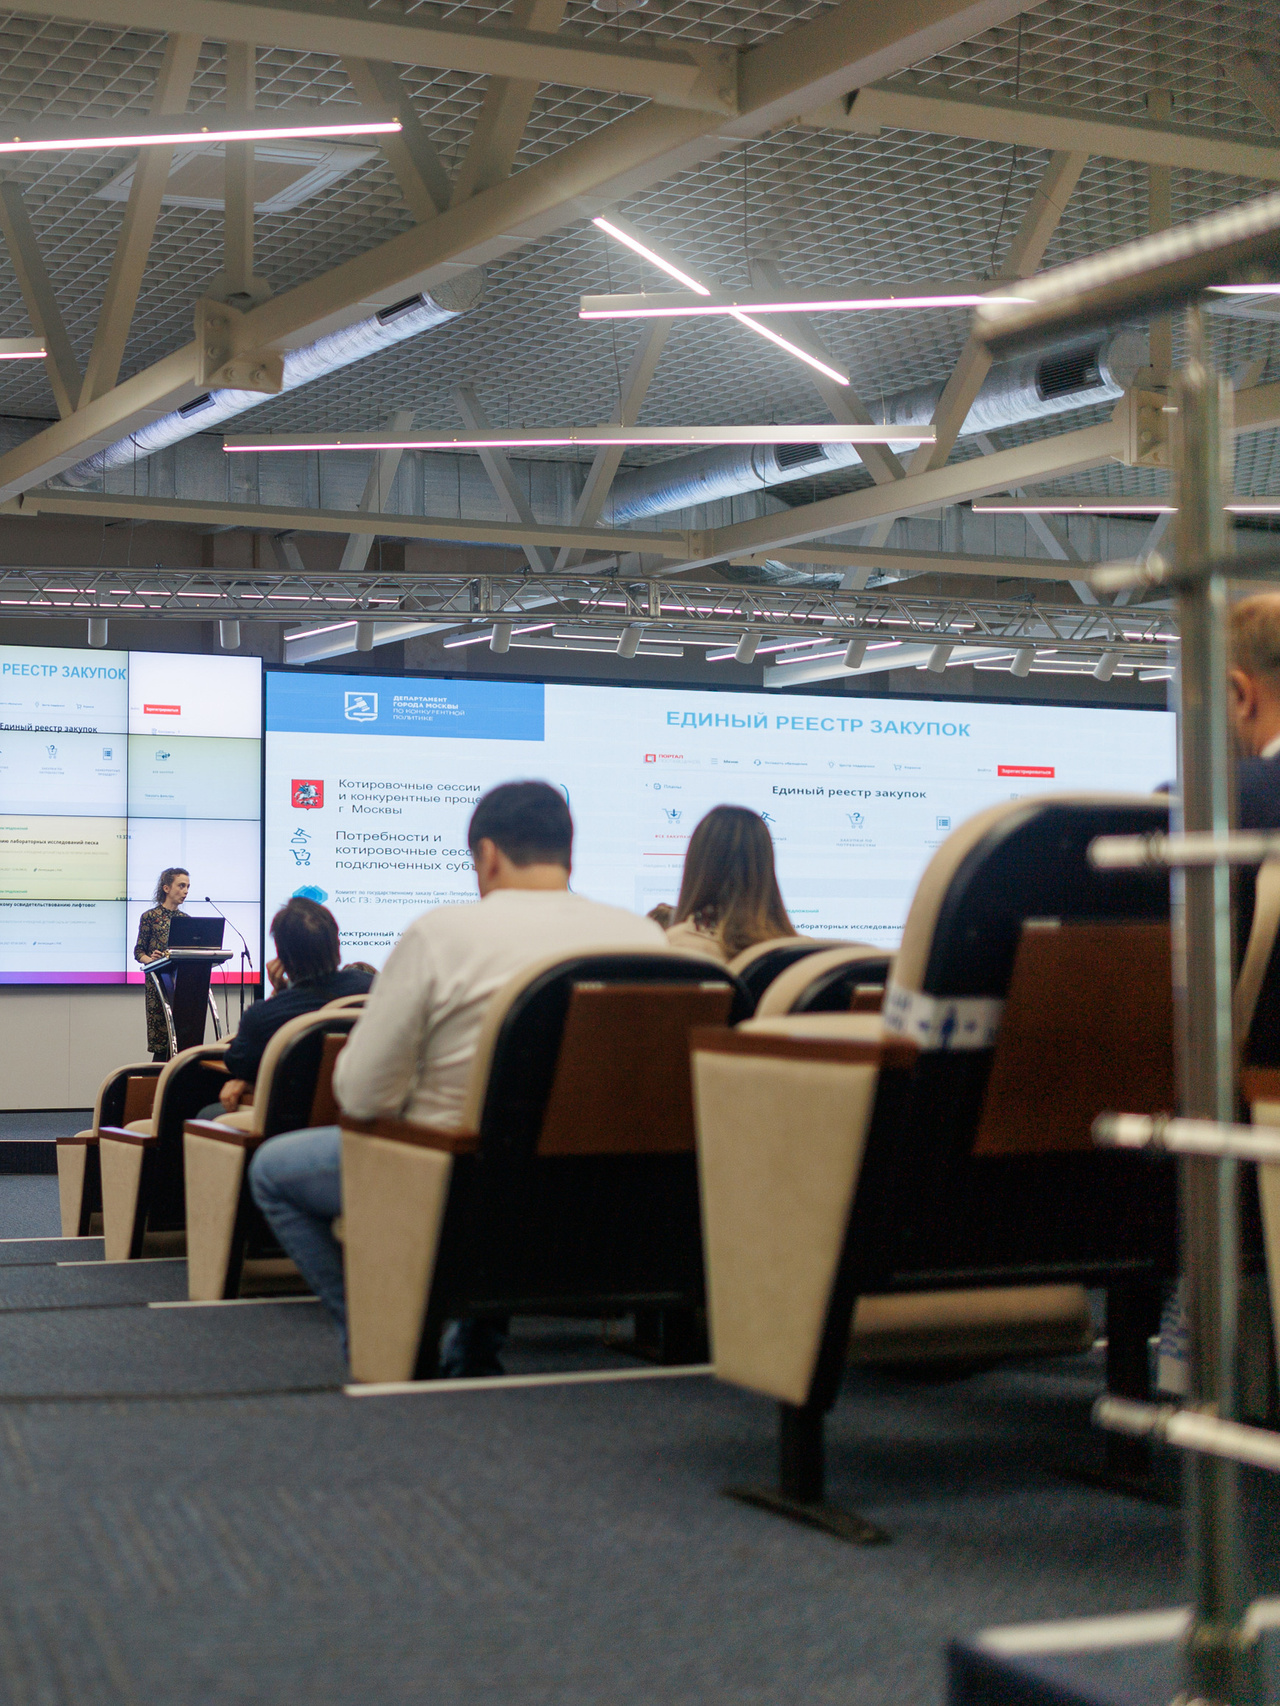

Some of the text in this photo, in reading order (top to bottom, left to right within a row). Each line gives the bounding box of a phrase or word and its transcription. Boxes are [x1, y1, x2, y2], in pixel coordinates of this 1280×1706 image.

[3, 663, 57, 677] РЕЕСТР
[62, 665, 126, 680] ЗАКУПОК
[406, 708, 465, 716] КОНКУРЕНТНОЙ
[0, 722, 33, 732] Единый
[35, 725, 63, 733] реестр
[667, 711, 971, 737] ЕДИНЫЙ РЕЕСТР ЗАКУПОК
[339, 779, 481, 792] Котировочные сессии
[772, 785, 927, 799] Единый реестр закупок
[351, 793, 441, 805] конкурентные
[444, 794, 483, 805] проце
[352, 805, 402, 815] Москвы
[336, 831, 430, 844] Потребности
[335, 845, 437, 857] котировочные
[335, 859, 442, 871] подключенных
[375, 896, 440, 905] Электронный
